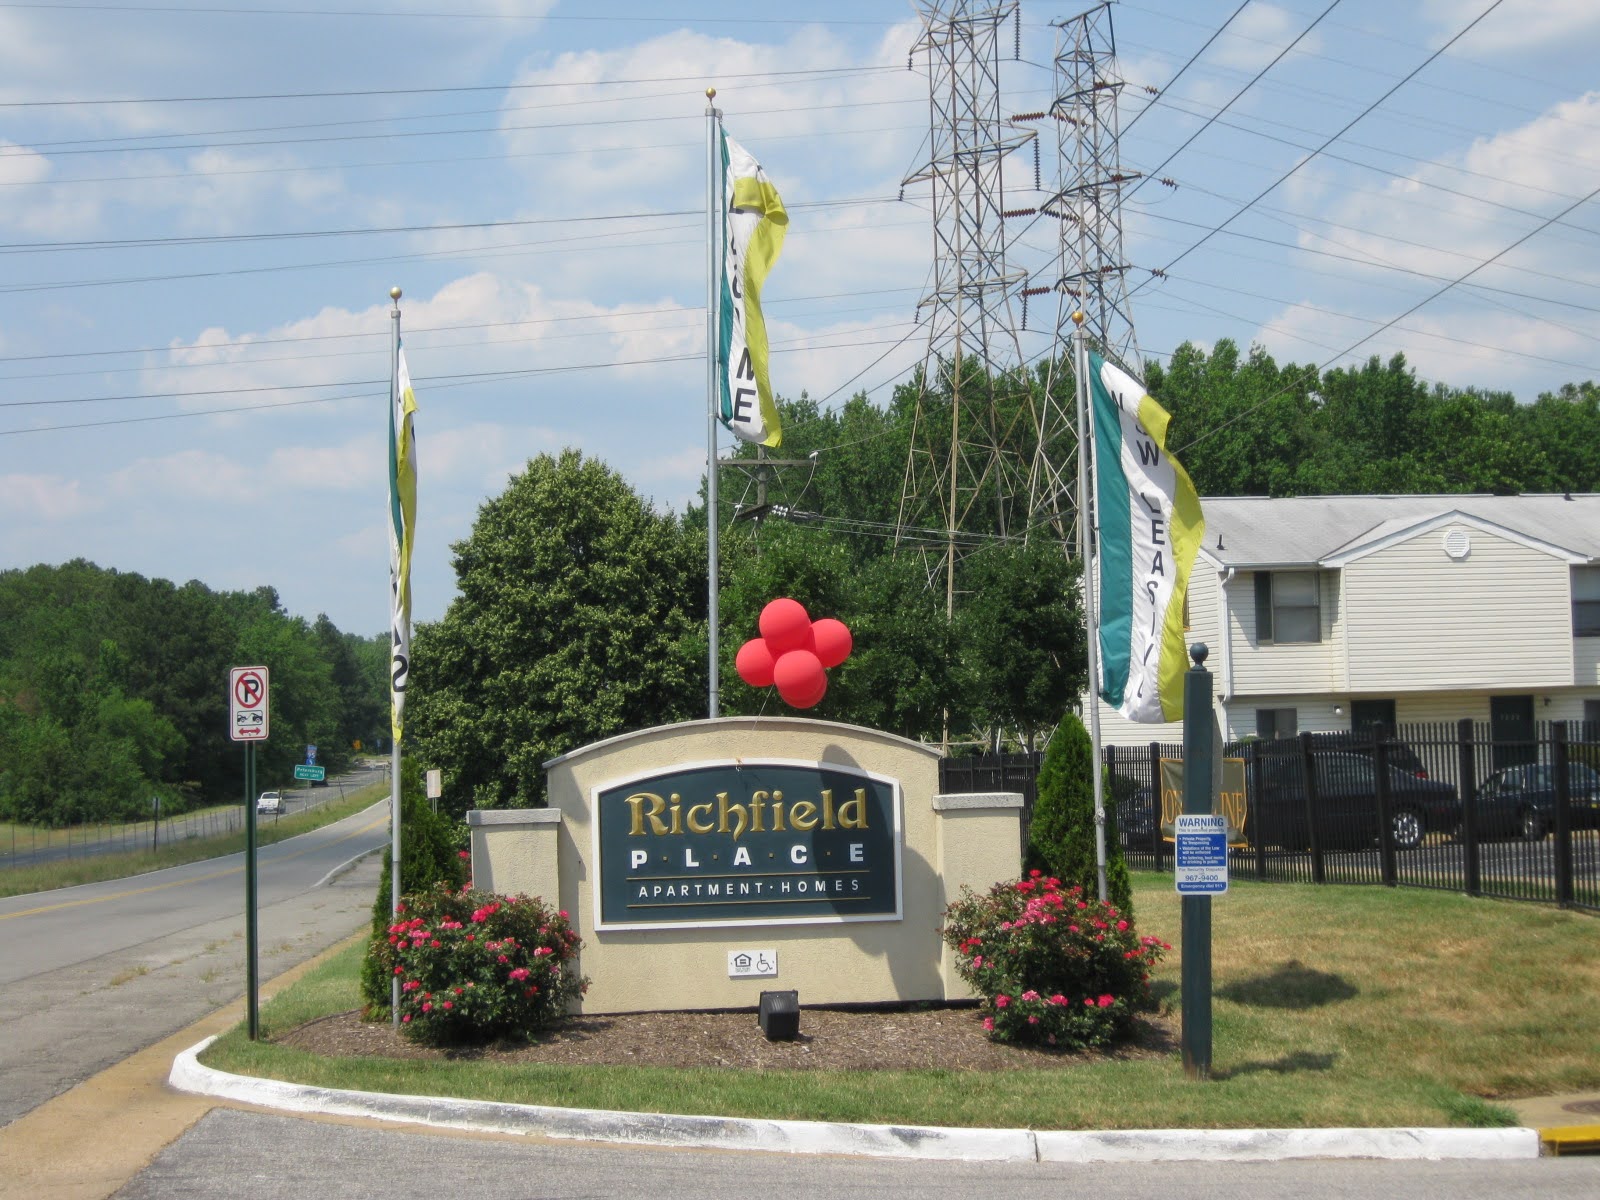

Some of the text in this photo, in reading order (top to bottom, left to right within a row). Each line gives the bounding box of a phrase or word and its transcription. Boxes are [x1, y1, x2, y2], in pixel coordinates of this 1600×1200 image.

[624, 788, 870, 842] Richfield
[1178, 817, 1224, 827] WARNING
[638, 879, 859, 898] APARTMENT HOMES
